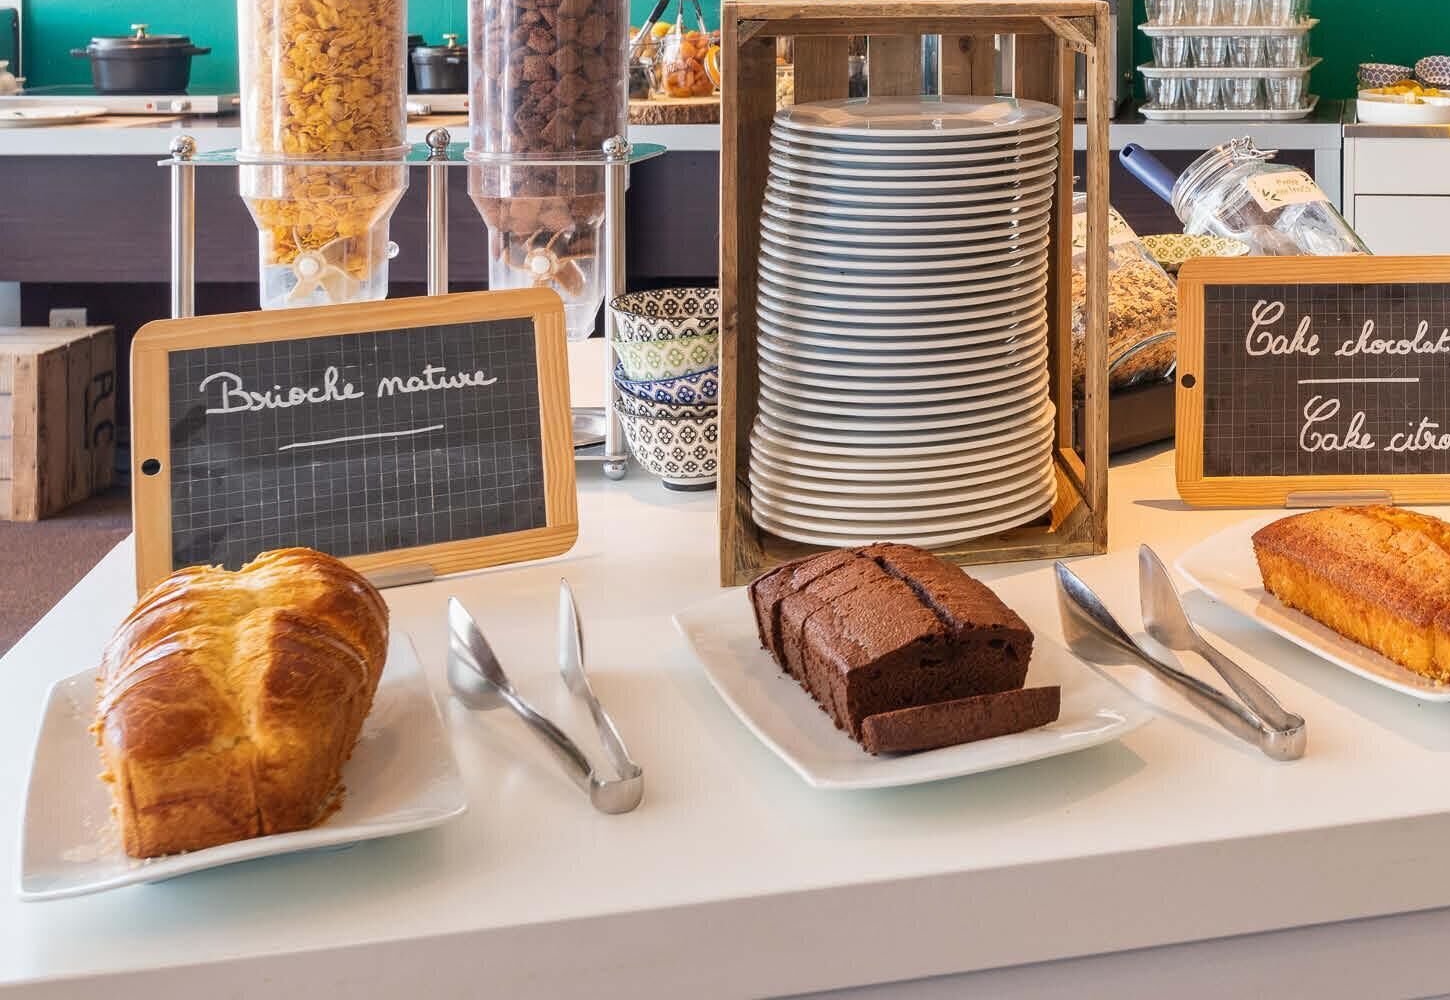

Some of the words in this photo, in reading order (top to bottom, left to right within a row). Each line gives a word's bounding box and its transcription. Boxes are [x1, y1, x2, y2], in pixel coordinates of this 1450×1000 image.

[1245, 299, 1321, 356] Cake
[199, 365, 365, 415] Brioche
[377, 363, 498, 398] nature
[1299, 395, 1376, 453] Cake
